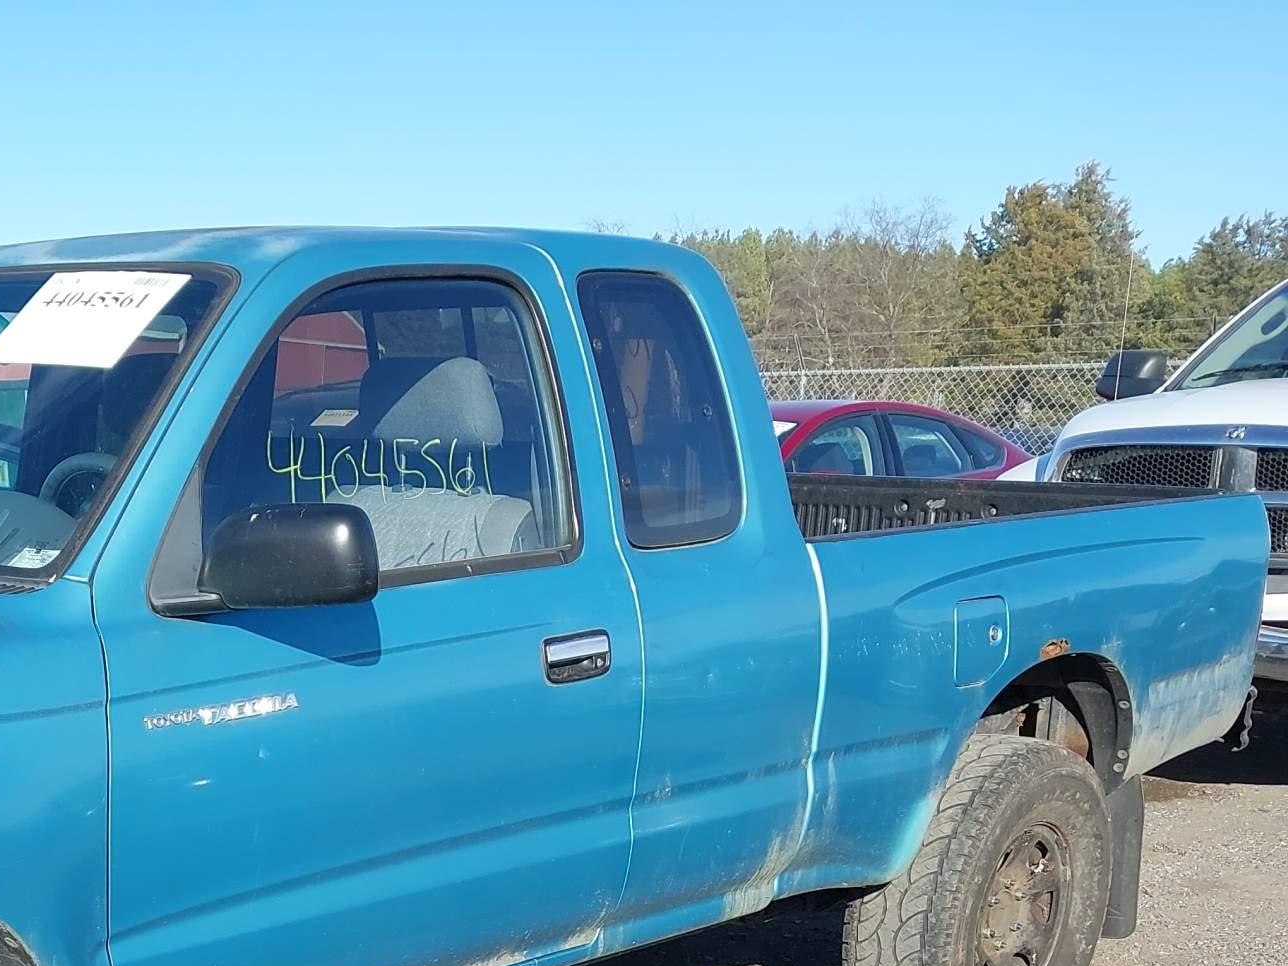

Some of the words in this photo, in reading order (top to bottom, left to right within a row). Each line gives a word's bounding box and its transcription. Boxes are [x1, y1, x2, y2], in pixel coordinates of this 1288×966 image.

[42, 290, 152, 309] 44045561
[267, 424, 494, 504] 44045561
[143, 708, 200, 731] TOYOTA
